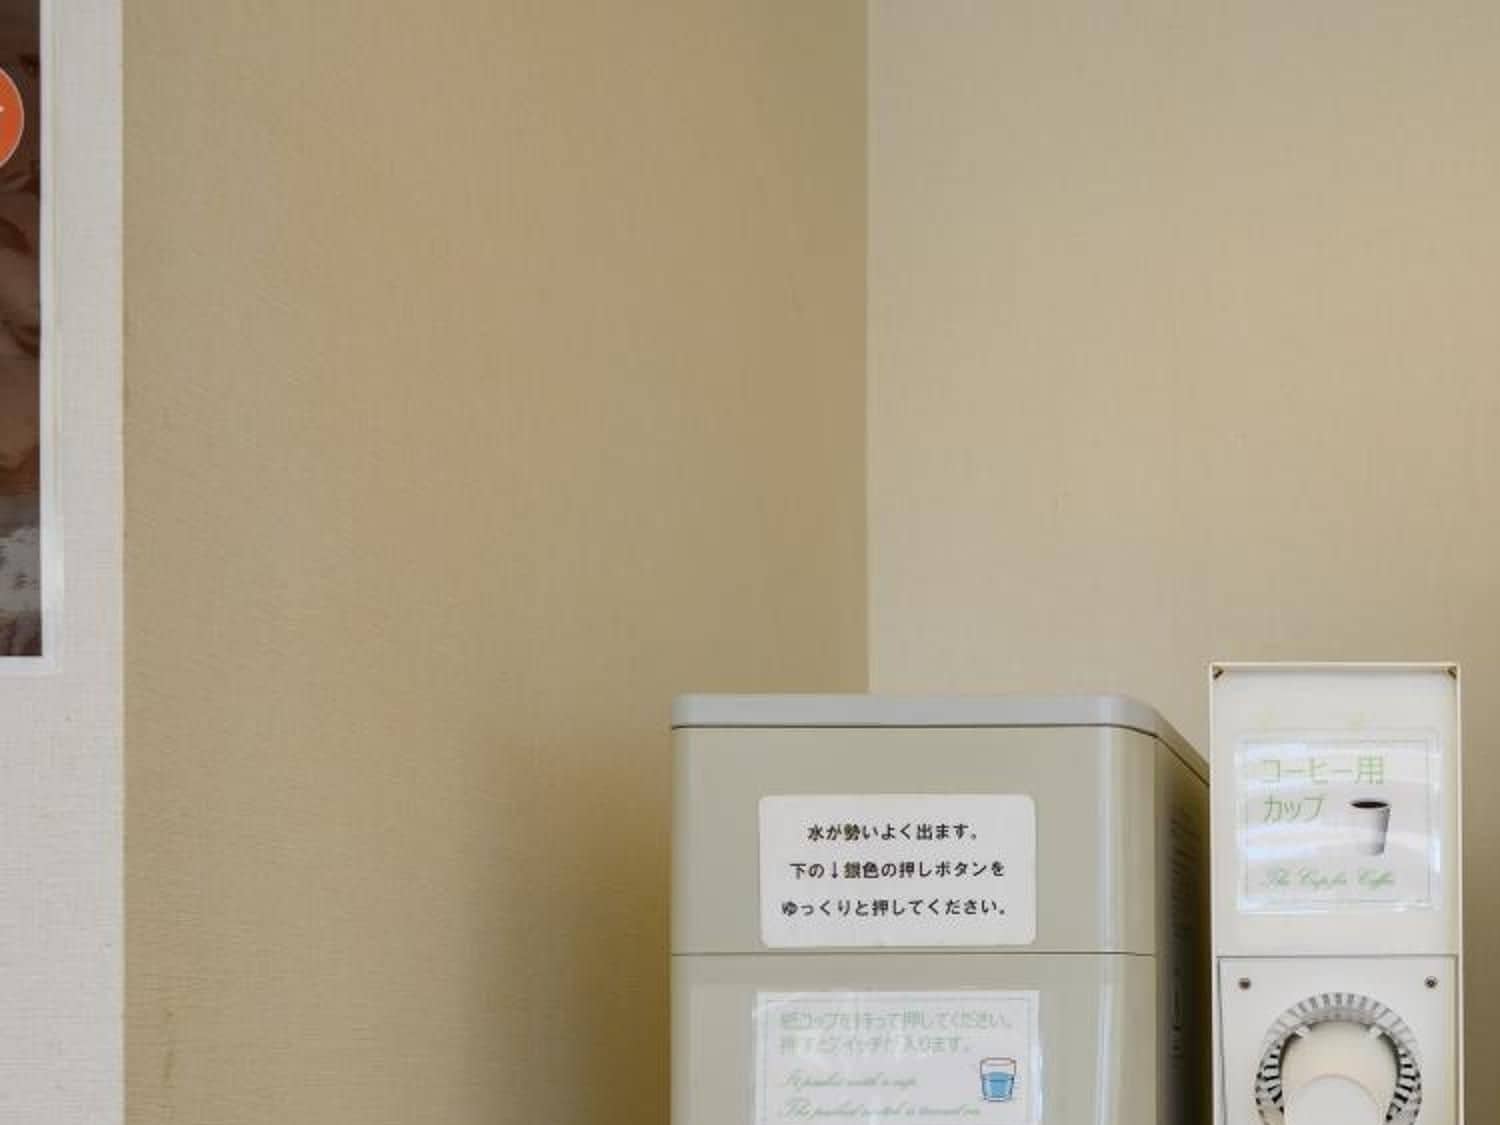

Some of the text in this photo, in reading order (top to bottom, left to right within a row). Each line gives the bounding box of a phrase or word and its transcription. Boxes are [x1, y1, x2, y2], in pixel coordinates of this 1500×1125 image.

[1263, 755, 1384, 784] コーヒー用
[1263, 794, 1328, 823] カップ
[807, 823, 977, 842] 水が勢いよく出ます。
[781, 899, 1005, 917] ゆっくりと押してください。
